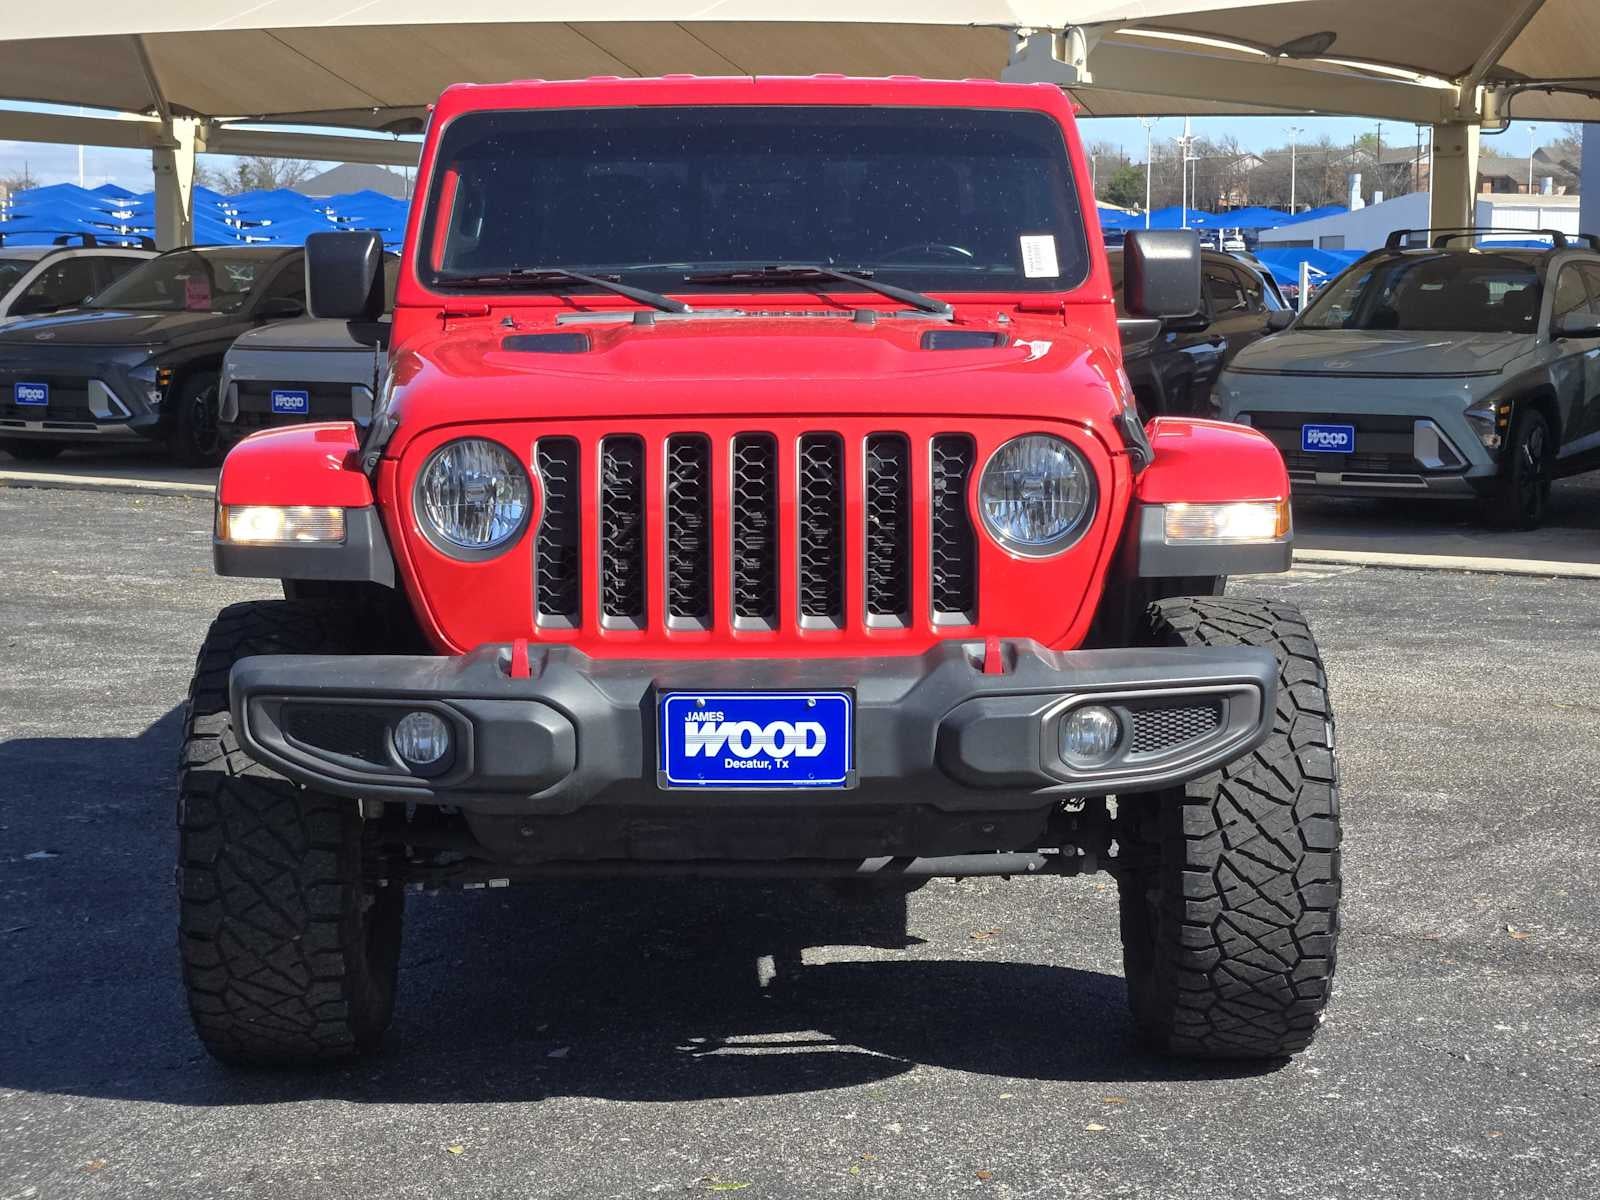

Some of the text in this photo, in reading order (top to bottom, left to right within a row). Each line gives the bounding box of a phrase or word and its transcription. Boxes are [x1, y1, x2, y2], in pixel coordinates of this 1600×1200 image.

[18, 388, 44, 400] WOOD
[275, 396, 304, 407] WOOD
[1307, 432, 1348, 445] WOOD
[684, 711, 725, 722] JAMES
[684, 721, 827, 759] WOOD
[724, 758, 789, 770] Decatur, Tx
